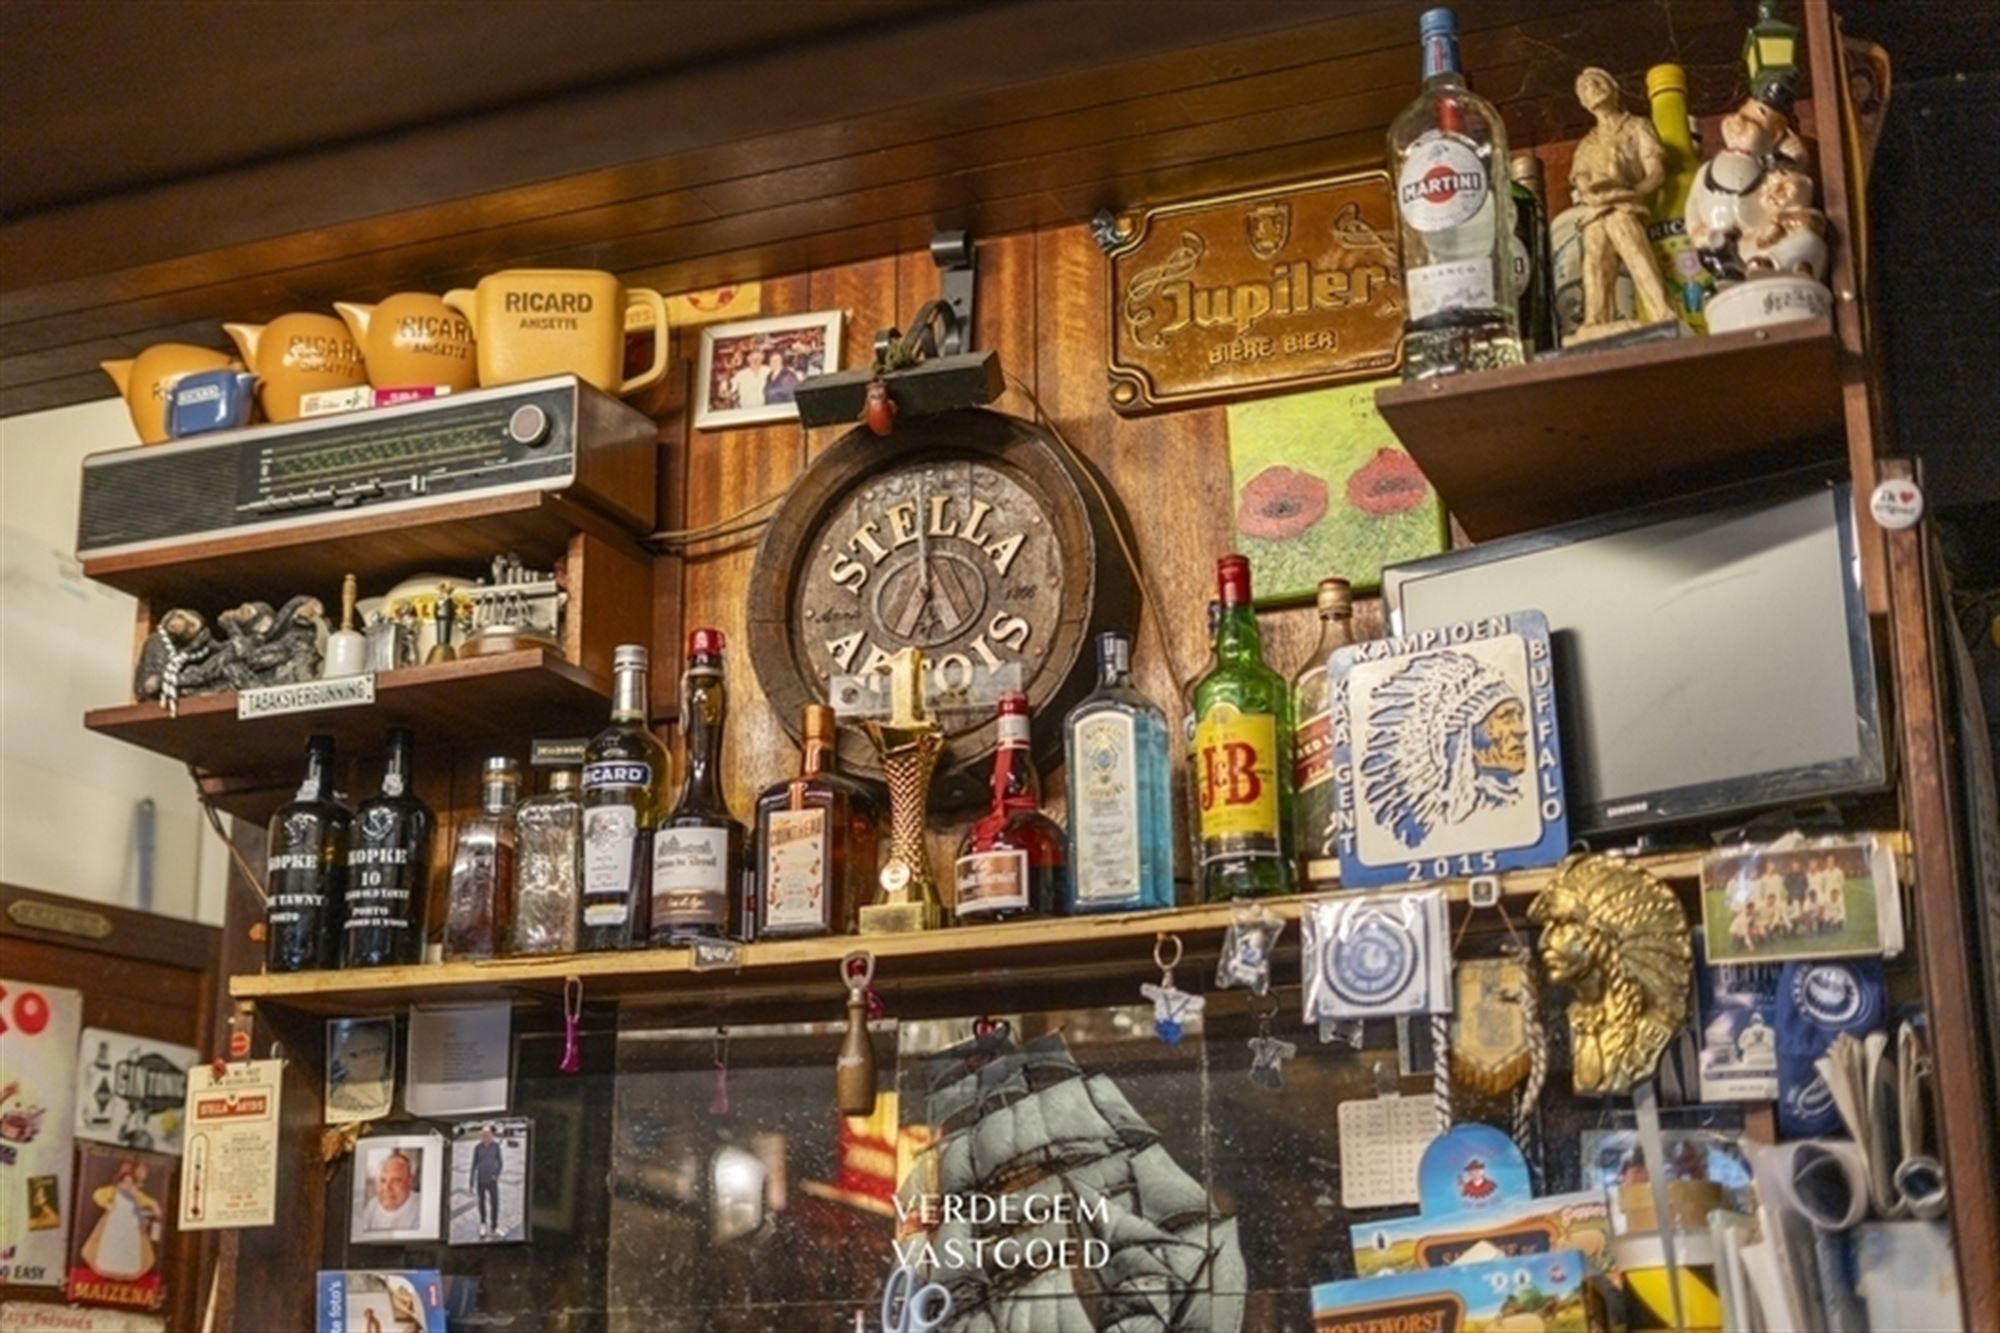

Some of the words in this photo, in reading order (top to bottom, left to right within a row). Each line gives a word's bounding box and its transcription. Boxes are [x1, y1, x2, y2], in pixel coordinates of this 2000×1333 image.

[1403, 172, 1481, 203] MARTINI
[505, 291, 593, 314] RICARD
[1162, 260, 1389, 334] Jupiler
[518, 318, 578, 331] ANISETTE
[413, 342, 466, 359] ANISETTE
[1283, 330, 1338, 353] BIER
[829, 496, 1027, 595] STELLA
[825, 610, 1030, 694] AROIS
[1354, 614, 1511, 665] KAMPIOEN
[1529, 638, 1562, 821] BUFFALO
[1335, 764, 1356, 855] GENT
[361, 871, 382, 887] 10
[1406, 853, 1498, 882] 2015
[280, 894, 324, 906] TAWNY
[14, 1265, 47, 1280] EASY
[75, 1281, 157, 1306] MAIZENA
